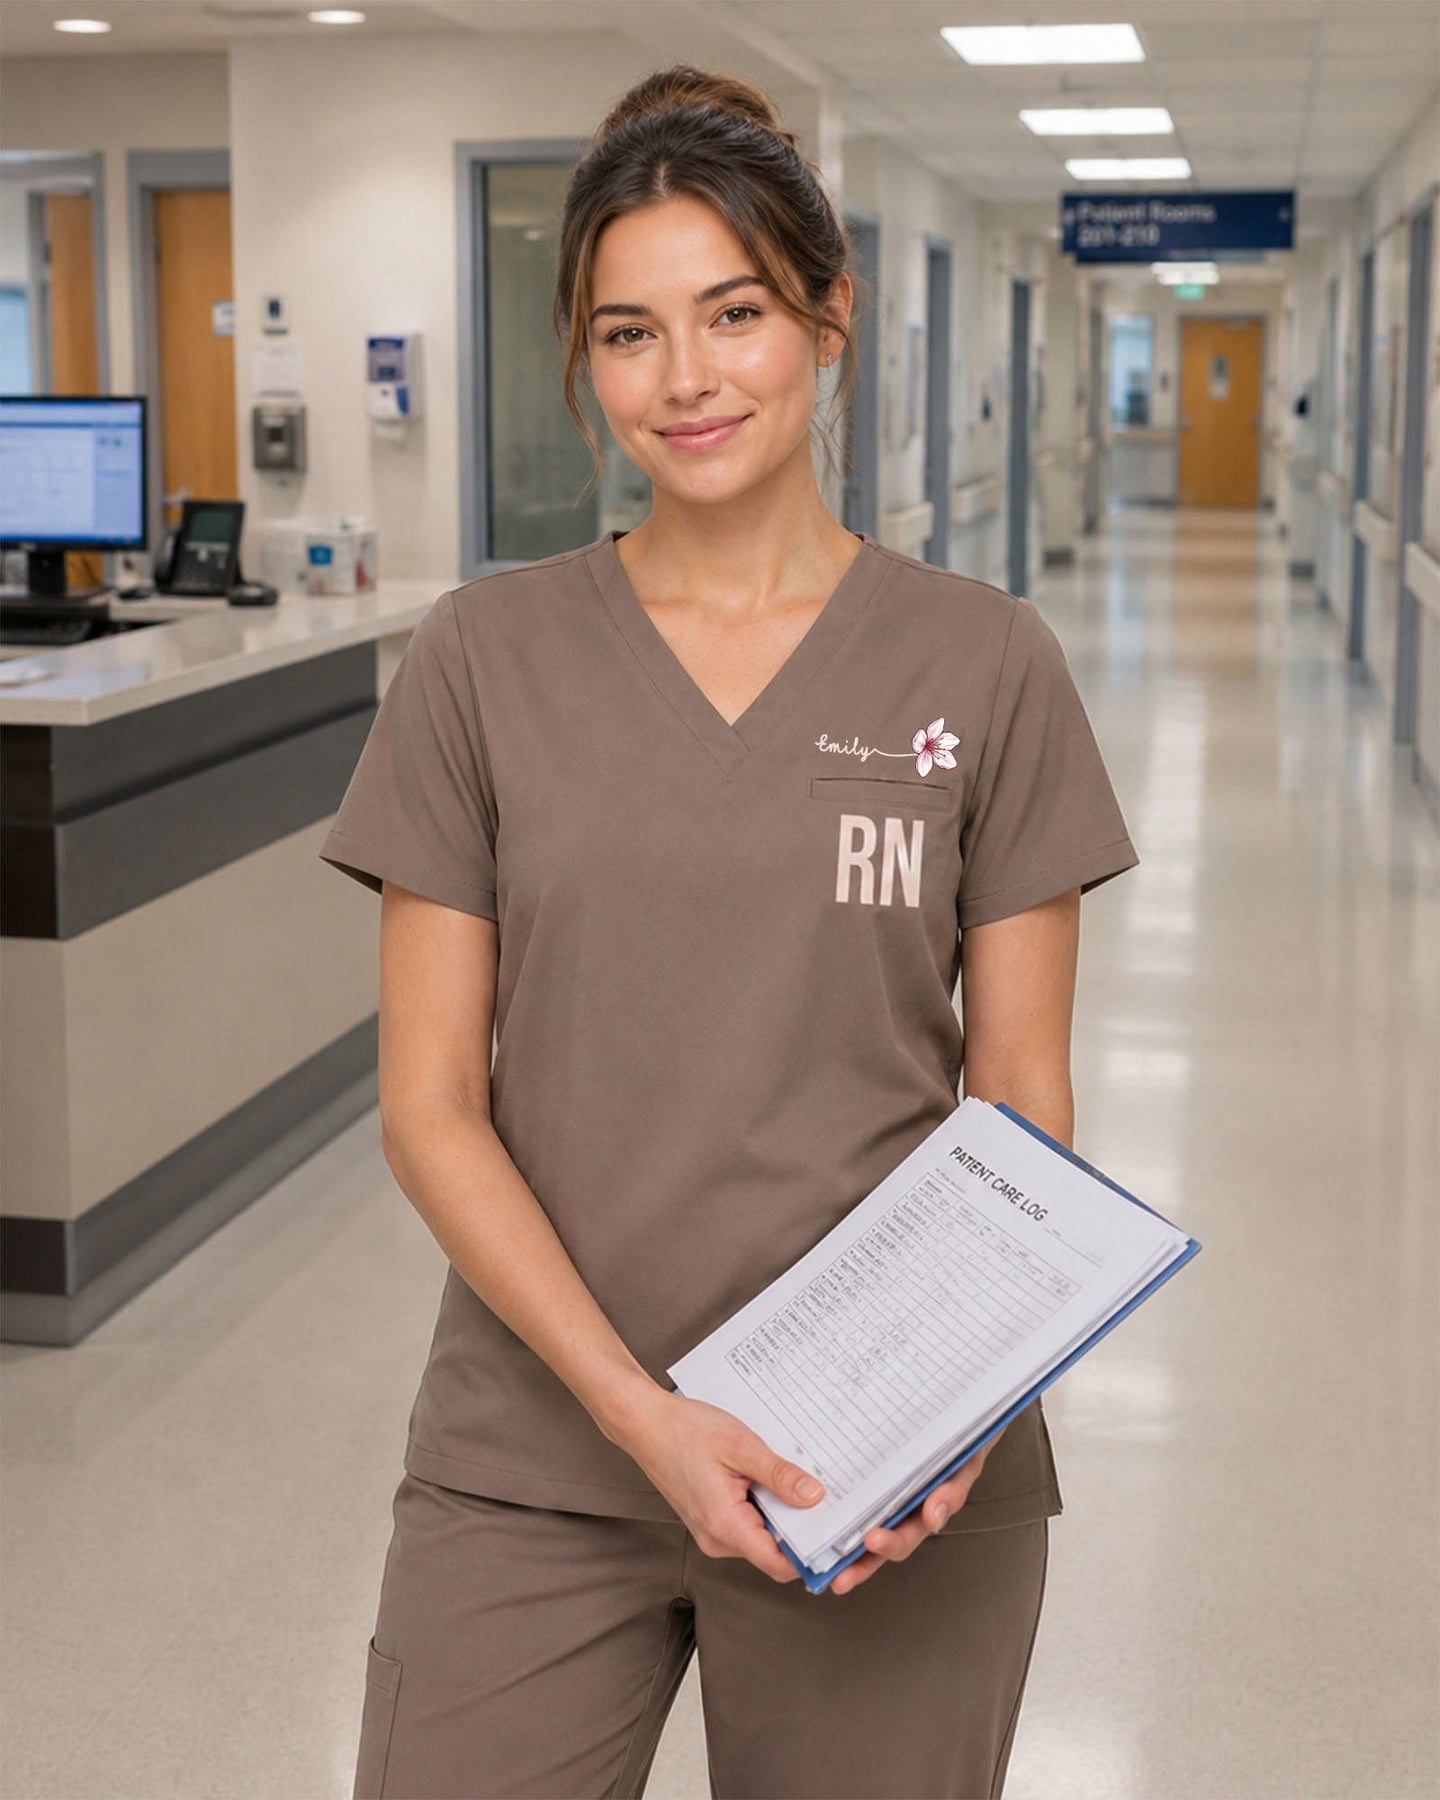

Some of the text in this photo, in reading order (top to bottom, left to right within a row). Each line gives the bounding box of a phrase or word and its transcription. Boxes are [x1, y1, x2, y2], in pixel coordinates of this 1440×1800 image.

[814, 733, 874, 763] Emily
[835, 813, 925, 909] RN
[949, 1146, 996, 1183] PATIENT
[990, 1177, 1024, 1205] CARE
[1019, 1198, 1049, 1222] LOG
